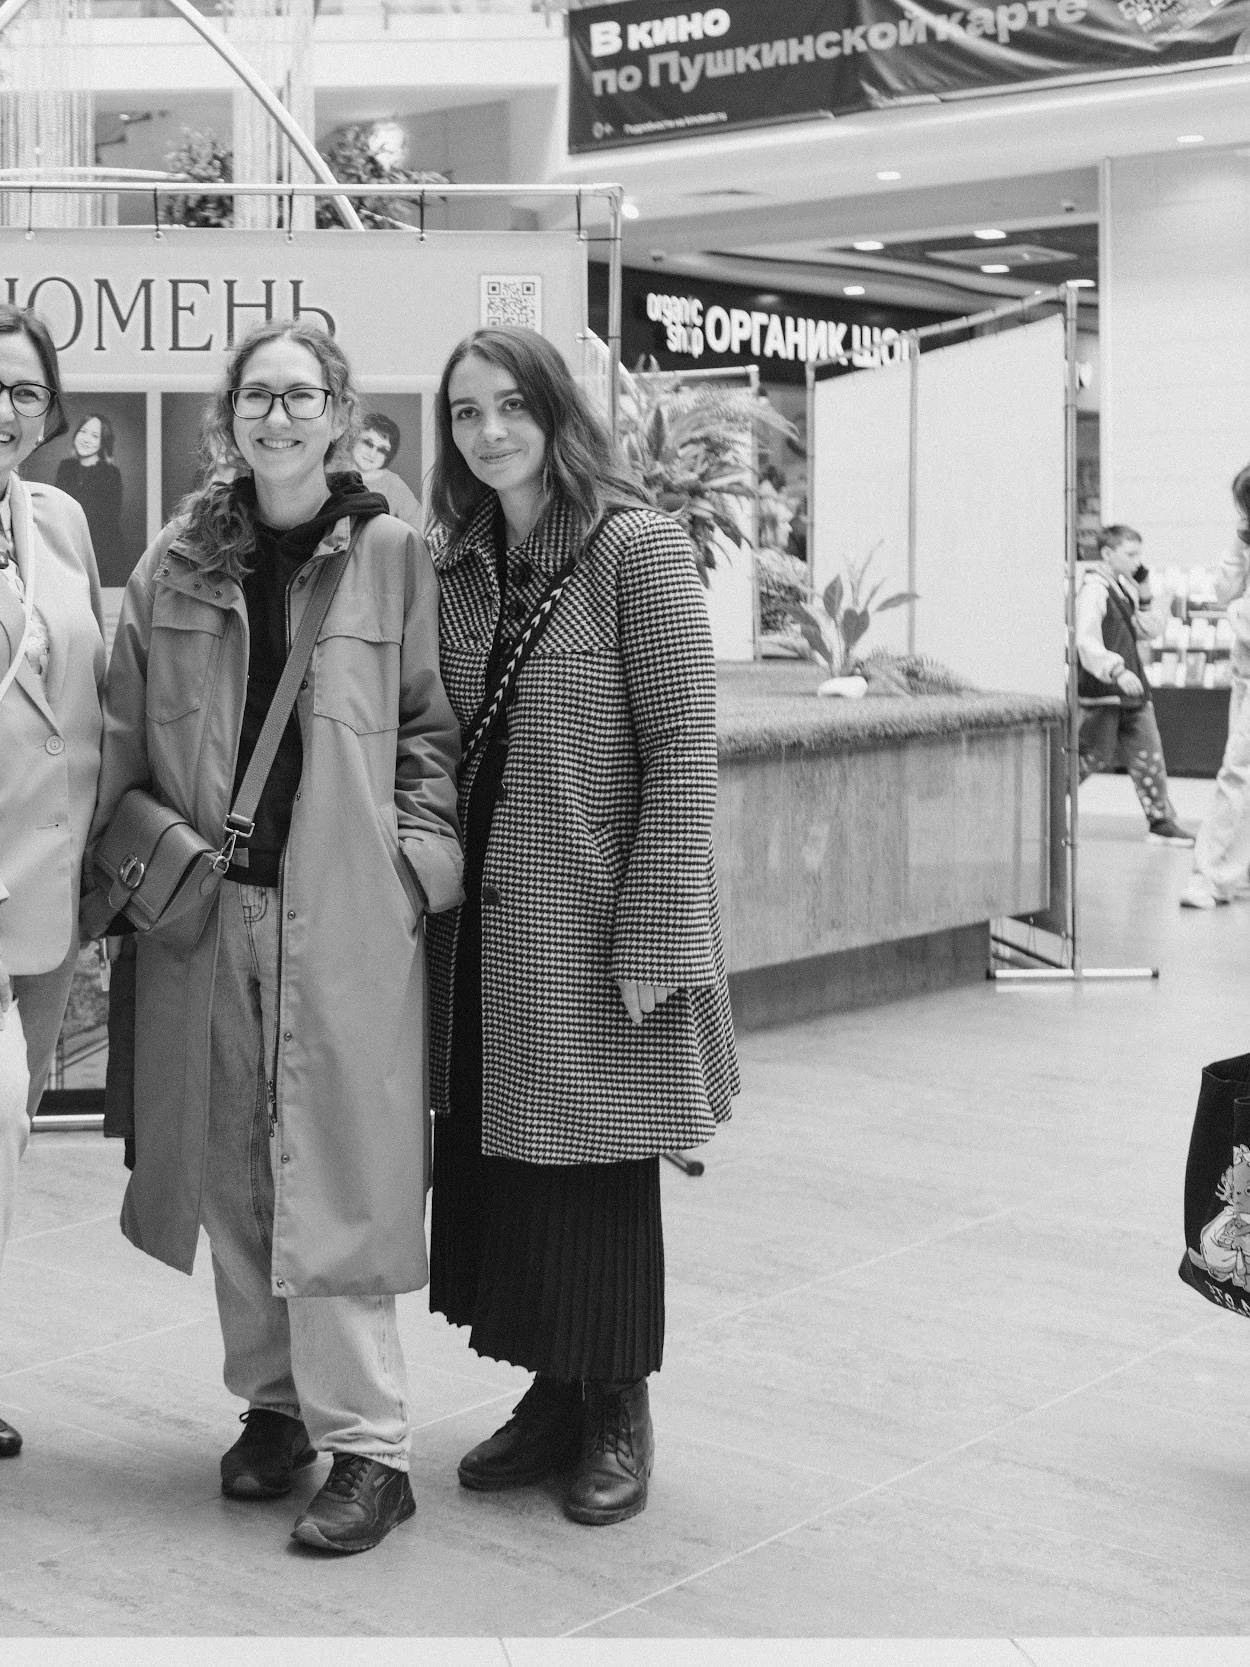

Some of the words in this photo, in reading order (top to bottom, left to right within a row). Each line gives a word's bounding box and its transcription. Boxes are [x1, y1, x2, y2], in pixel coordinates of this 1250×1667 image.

[589, 20, 623, 58] В
[627, 8, 731, 51] кино
[592, 65, 643, 96] по
[648, 9, 928, 94] Пушкинской
[705, 305, 849, 366] ОРГАНИК
